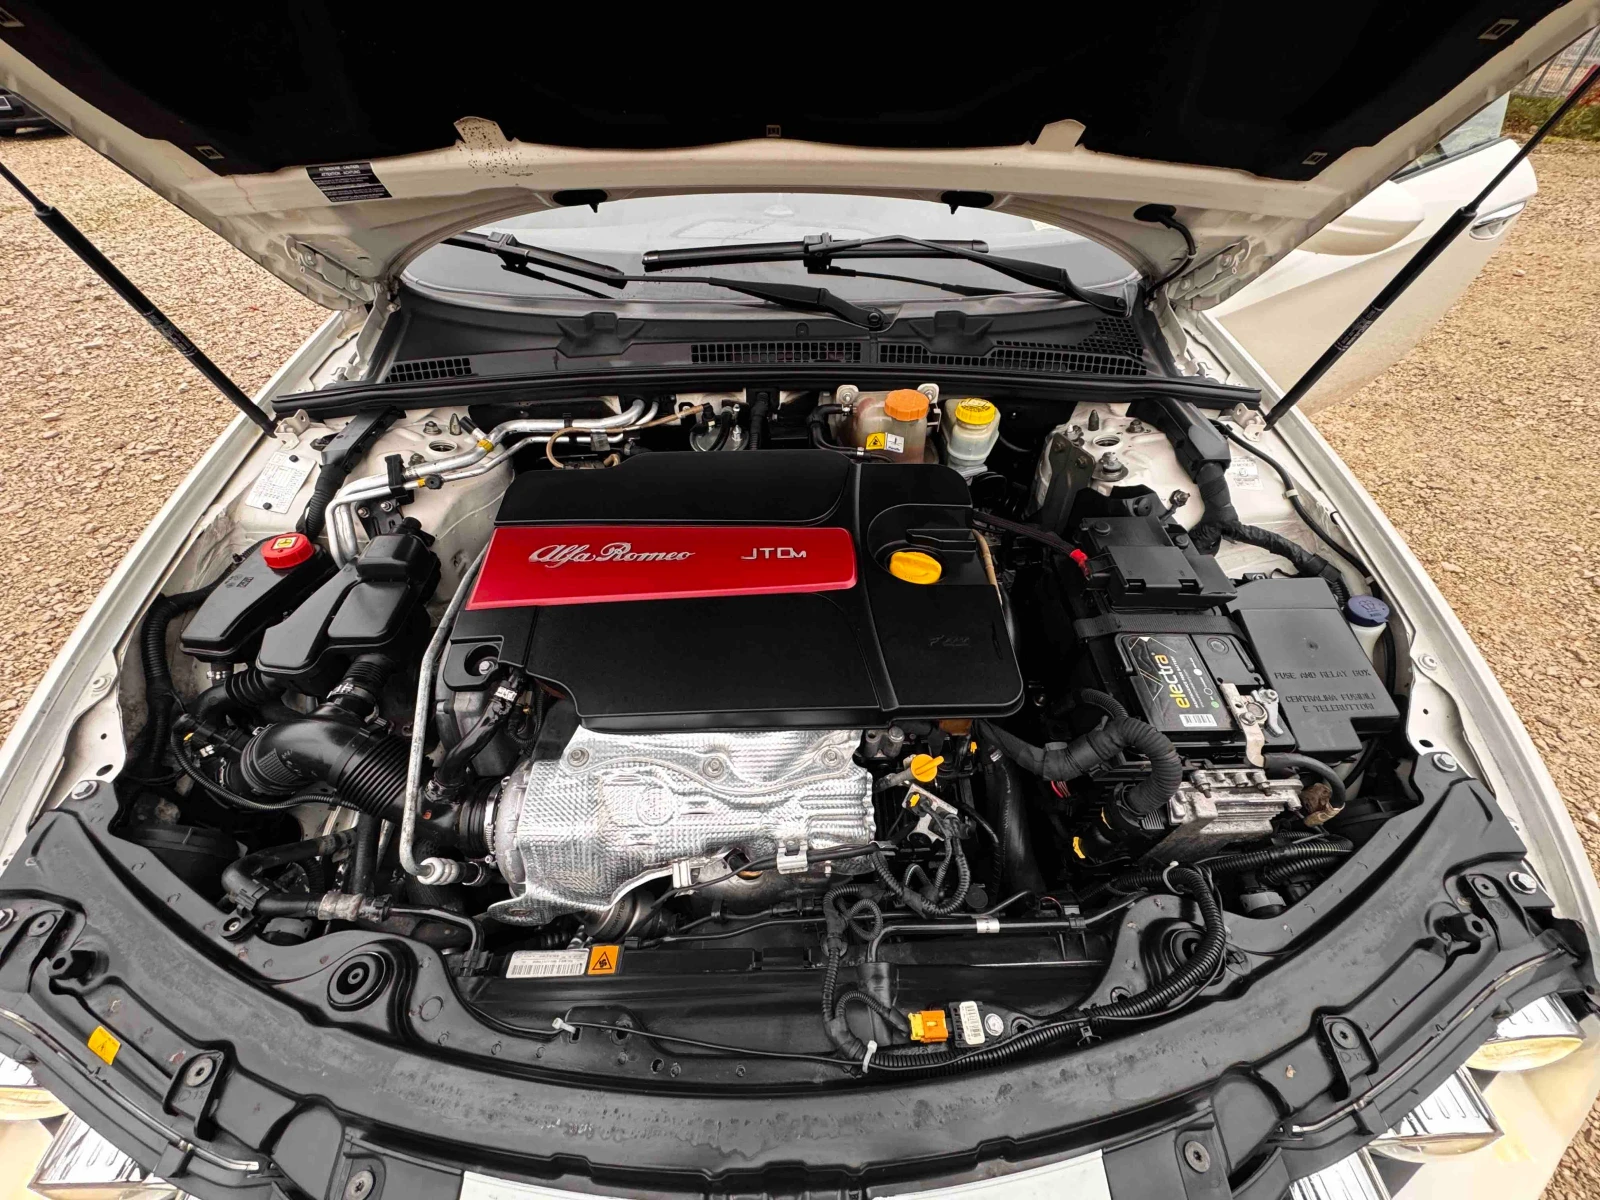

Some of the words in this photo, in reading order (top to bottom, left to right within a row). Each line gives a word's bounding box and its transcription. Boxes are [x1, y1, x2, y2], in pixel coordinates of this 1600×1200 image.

[528, 544, 596, 568] Alfa
[595, 542, 696, 562] Romeo
[1273, 672, 1297, 680] FUSE
[1300, 671, 1317, 679] AND
[1319, 670, 1348, 678] RELAY
[1352, 669, 1372, 677] BOX
[1154, 654, 1191, 709] electra
[1285, 693, 1339, 703] CENTRALINA
[1302, 705, 1311, 713] E
